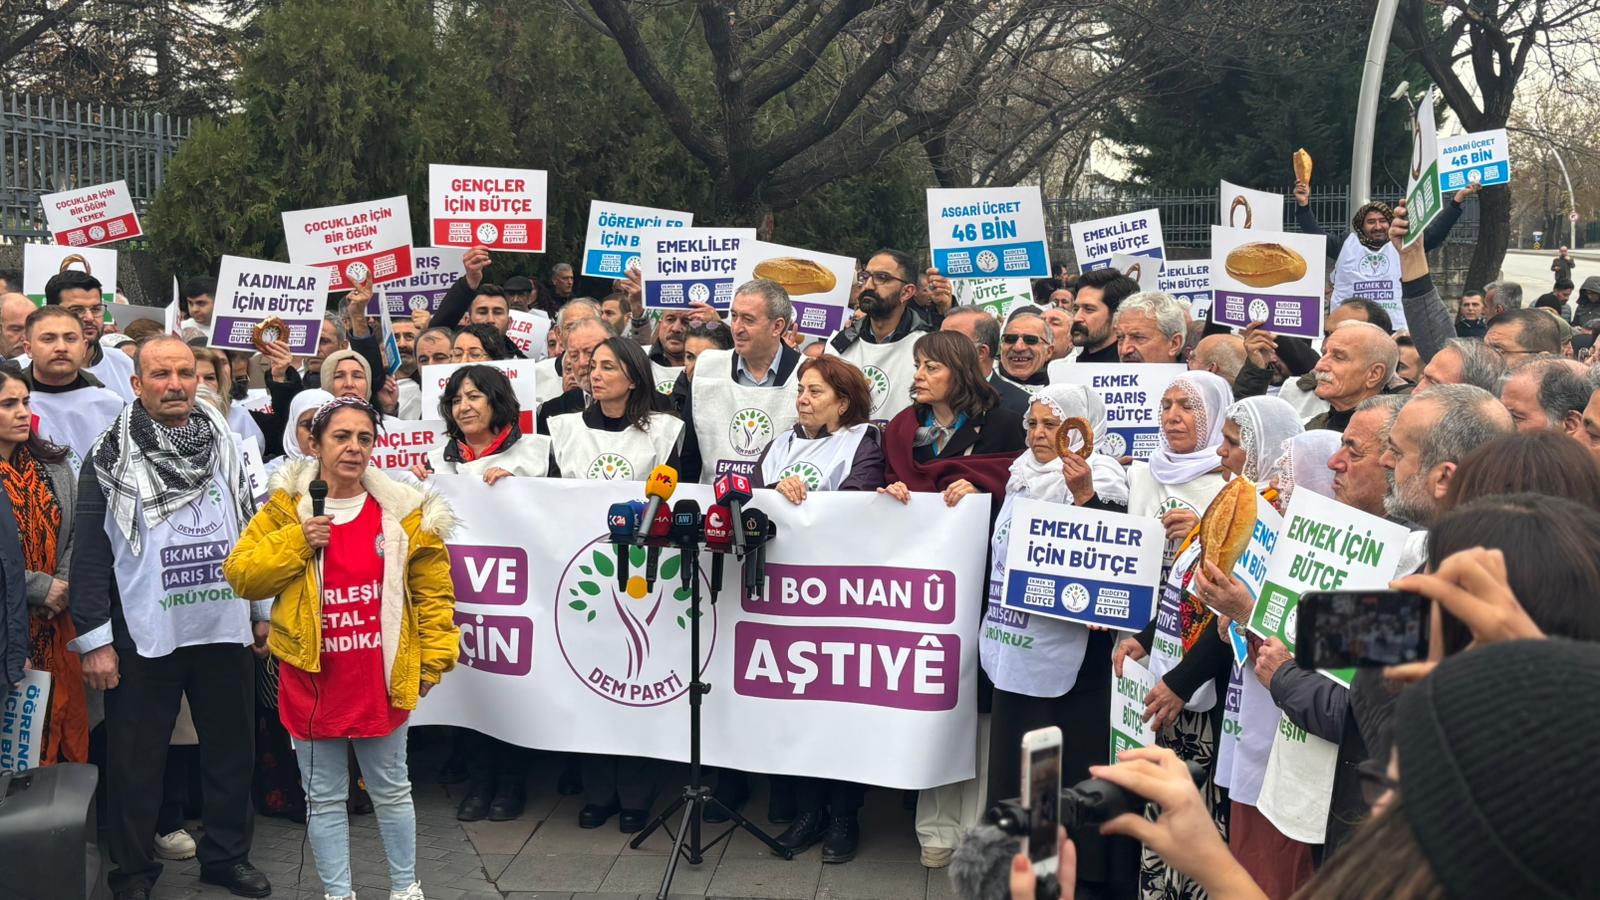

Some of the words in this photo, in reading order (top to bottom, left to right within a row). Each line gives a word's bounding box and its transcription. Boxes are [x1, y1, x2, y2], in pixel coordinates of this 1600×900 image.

[1443, 142, 1470, 155] ASGARİ
[1472, 138, 1495, 150] ÜCRET
[1451, 154, 1468, 167] 46
[1471, 148, 1493, 164] BİN
[451, 178, 525, 195] GENÇLER
[56, 193, 98, 210] ÇOCUKLAR
[99, 187, 116, 199] İÇİN
[444, 195, 476, 215] İÇİN
[479, 195, 532, 215] BÜTÇE
[70, 206, 84, 216] BİR
[84, 201, 107, 213] ÖĞÜN
[77, 211, 106, 224] YEMEK
[941, 202, 981, 218] ASGARİ
[982, 201, 1021, 215] ÜCRET
[304, 213, 368, 233] ÇOCUKLAR
[370, 207, 392, 221] İÇİN
[951, 223, 978, 242] 46
[981, 216, 1017, 240] BİN
[324, 230, 344, 244] BİR
[346, 225, 378, 241] ÖĞÜN
[1083, 218, 1147, 243] EMEKLİLER
[333, 240, 373, 256] YEMEK
[600, 231, 629, 249] İÇİN
[656, 235, 740, 254] EMEKLİLER
[1086, 242, 1109, 258] İÇİN
[1110, 234, 1150, 253] BÜTÇE
[416, 256, 440, 271] RIŞ
[657, 257, 687, 276] İÇİN
[238, 272, 316, 291] KADINLAR
[410, 272, 459, 289] BÜTÇE
[1158, 279, 1176, 291] İÇİN
[1178, 277, 1210, 290] BÜTÇE
[1355, 281, 1381, 290] EKMEK
[1383, 281, 1392, 289] VE
[974, 283, 1007, 299] ÜTÇE
[232, 291, 265, 313] İÇİN
[267, 293, 315, 316] BÜTÇE
[1093, 374, 1139, 388] EKMEK
[1105, 391, 1147, 406] BARIŞ
[1107, 405, 1152, 423] BÜTÇE
[374, 430, 435, 450] NÇLER
[718, 462, 755, 474] EKMEK
[720, 482, 726, 494] 8
[737, 478, 745, 490] 8
[177, 524, 194, 535] DEM
[196, 521, 218, 534] PARTİ
[1029, 519, 1143, 547] EMEKLİLER
[1286, 515, 1340, 554] EKMEK
[1339, 525, 1385, 568] İÇİN
[1027, 540, 1065, 567] İÇİN
[1069, 547, 1138, 577] BÜTÇE
[464, 556, 517, 594] VE
[781, 577, 827, 606] BO
[839, 578, 912, 608] NAN
[923, 573, 945, 612] Û
[1025, 594, 1053, 607] BÜTÇE
[321, 610, 365, 628] ETAL
[1096, 606, 1127, 616] AŞTIYÊ
[459, 614, 520, 667] ÇİN
[744, 634, 945, 695] AŞTIYÊ
[588, 667, 627, 699] DEM
[631, 669, 683, 701] PARTİ
[2, 689, 23, 734] İÇİN
